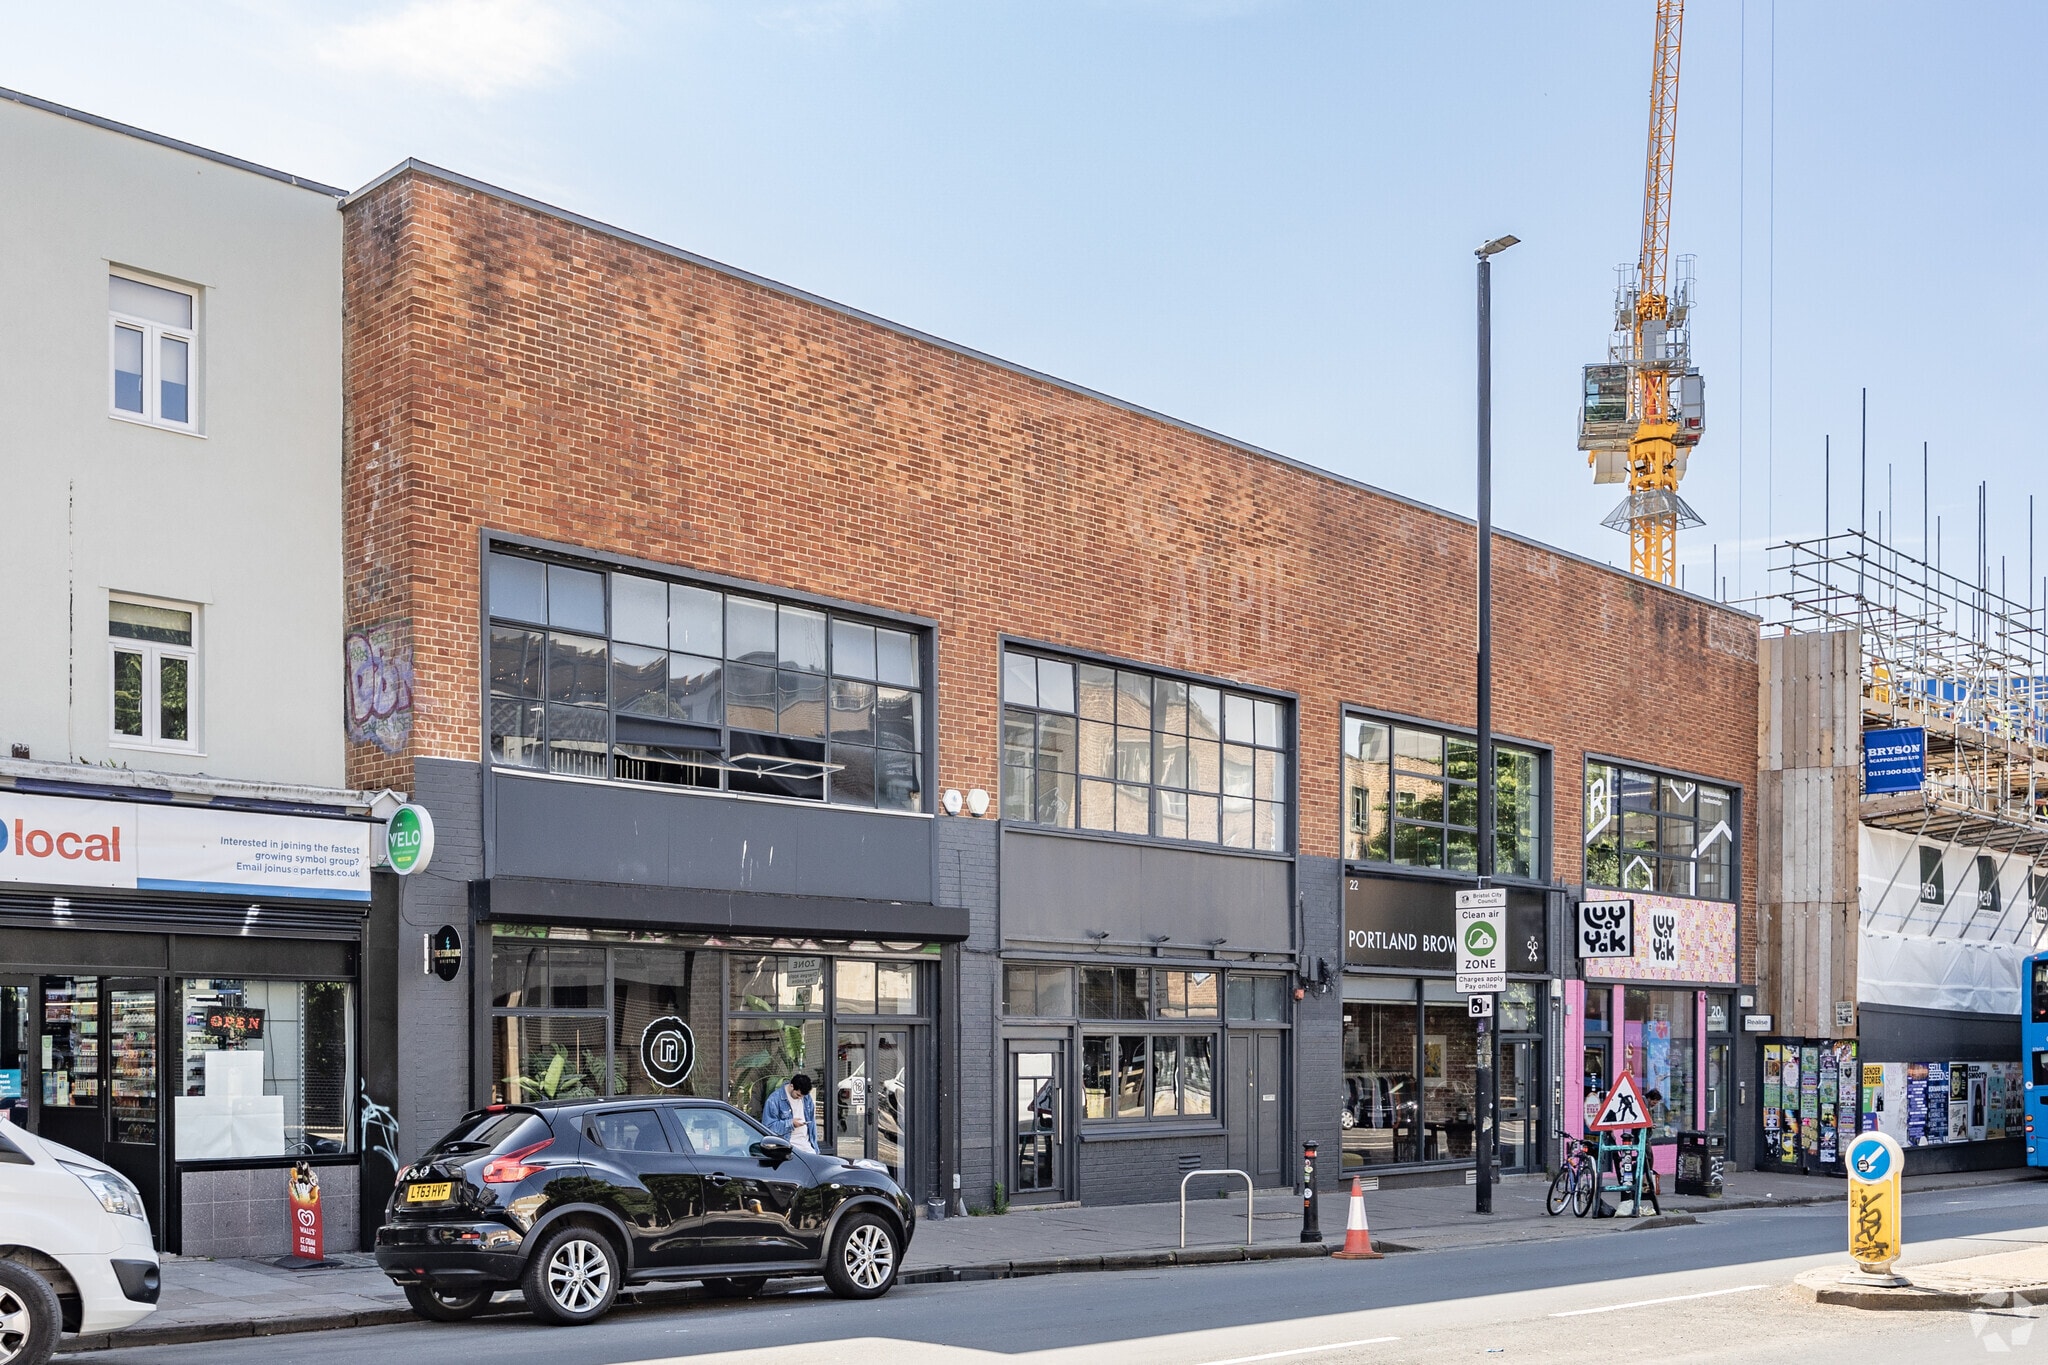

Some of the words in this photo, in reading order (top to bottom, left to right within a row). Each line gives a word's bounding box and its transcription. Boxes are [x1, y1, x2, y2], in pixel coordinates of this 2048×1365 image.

[1867, 744, 1920, 757] BRYSON
[15, 817, 121, 863] local
[220, 836, 267, 848] Interested
[270, 840, 278, 848] in
[280, 841, 312, 852] joining
[314, 843, 328, 852] the
[331, 844, 360, 854] fastest
[255, 851, 292, 863] growing
[295, 854, 326, 864] symbol
[329, 857, 360, 867] group?
[236, 862, 262, 872] Email
[1349, 880, 1359, 891] 22
[1462, 911, 1486, 919] Clean
[1488, 910, 1500, 918] air
[1349, 930, 1417, 951] PORTLAND
[1465, 959, 1496, 969] ZONE
[1486, 975, 1504, 983] apply
[1465, 983, 1477, 991] Pay
[1477, 982, 1498, 990] online
[210, 1015, 260, 1030] OPEN
[1863, 1067, 1881, 1076] GENDER
[1863, 1076, 1882, 1085] STORIES
[411, 1185, 431, 1199] LT63
[431, 1184, 448, 1198] HVF
[299, 1226, 316, 1236] WALL'S
[300, 1245, 308, 1253] SOLD
